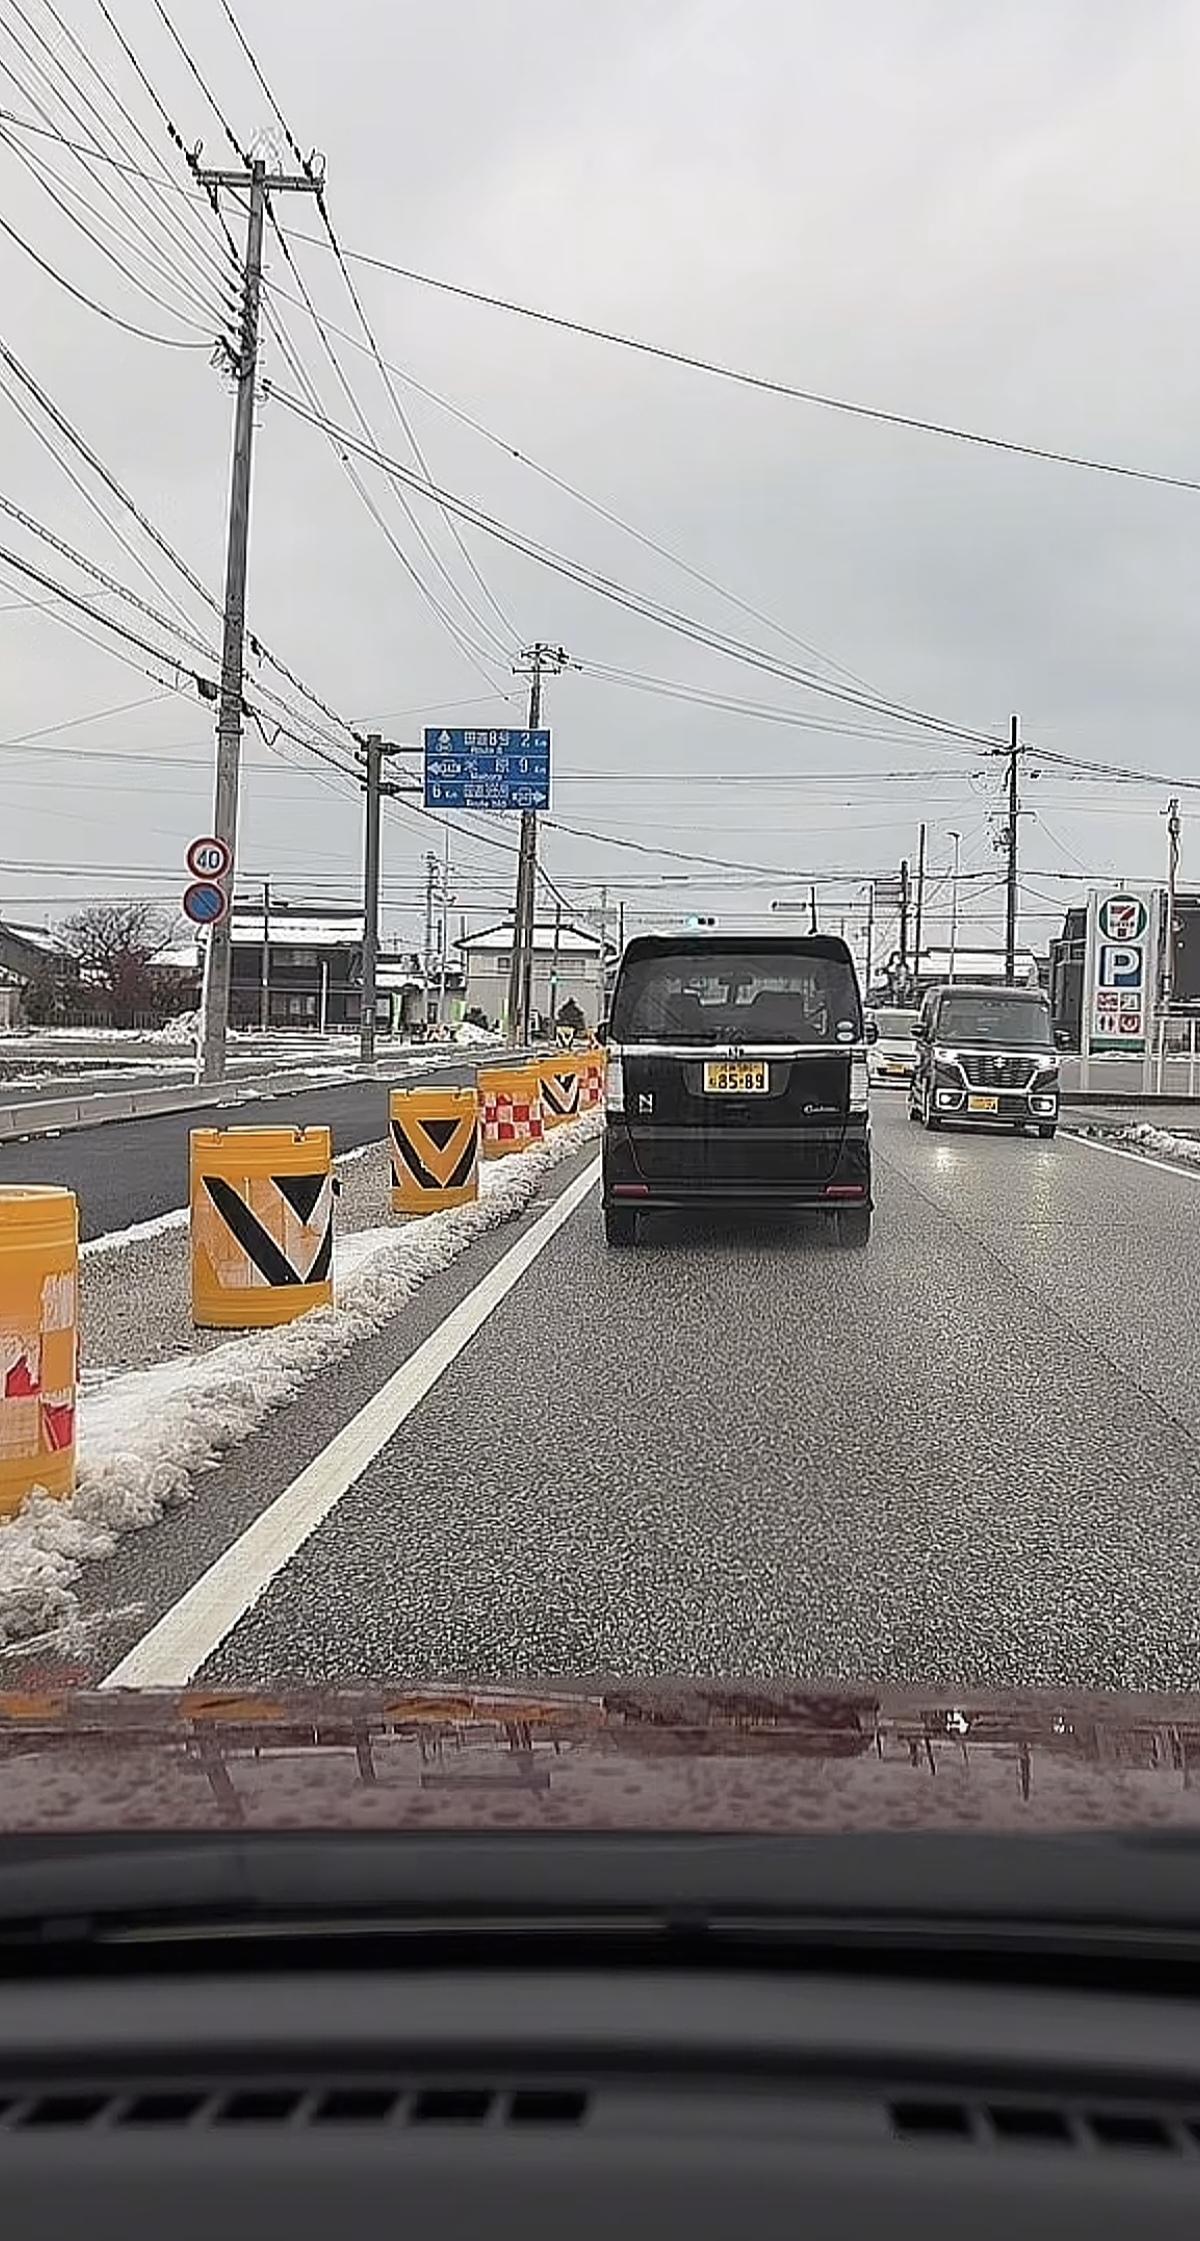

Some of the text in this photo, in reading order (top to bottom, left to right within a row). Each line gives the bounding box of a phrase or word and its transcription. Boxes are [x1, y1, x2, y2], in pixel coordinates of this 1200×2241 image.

[520, 731, 530, 748] 2
[432, 783, 441, 799] 6
[197, 849, 220, 869] 40
[1103, 947, 1140, 986] P
[638, 1093, 653, 1114] N
